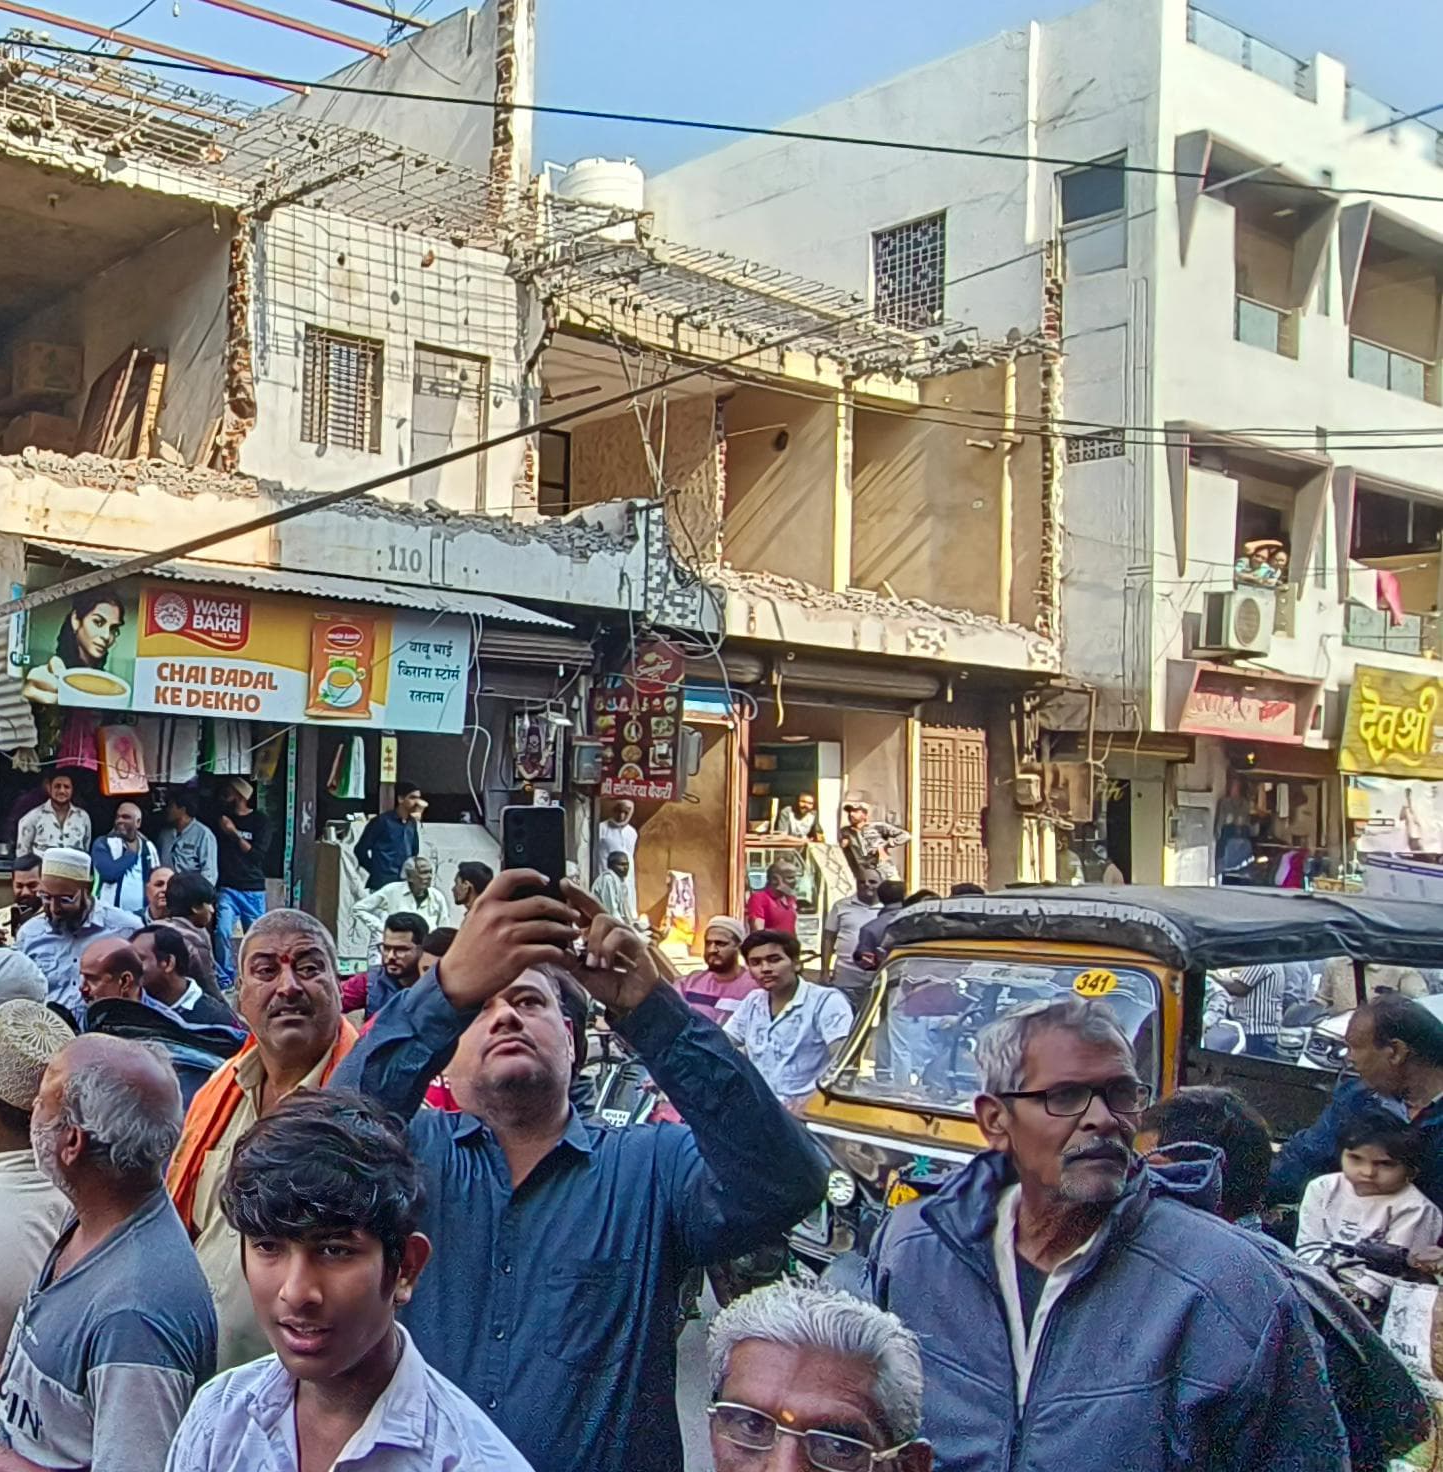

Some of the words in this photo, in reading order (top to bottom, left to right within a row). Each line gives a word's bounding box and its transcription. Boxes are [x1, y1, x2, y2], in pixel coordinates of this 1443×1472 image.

[388, 544, 423, 573] 110
[192, 600, 242, 618] WAGH
[192, 614, 242, 633] BAKRI
[156, 662, 206, 684] CHAI
[210, 666, 278, 690] BADAL
[154, 685, 183, 706] KE
[185, 688, 261, 713] DEKHO
[1076, 973, 1111, 993] 341
